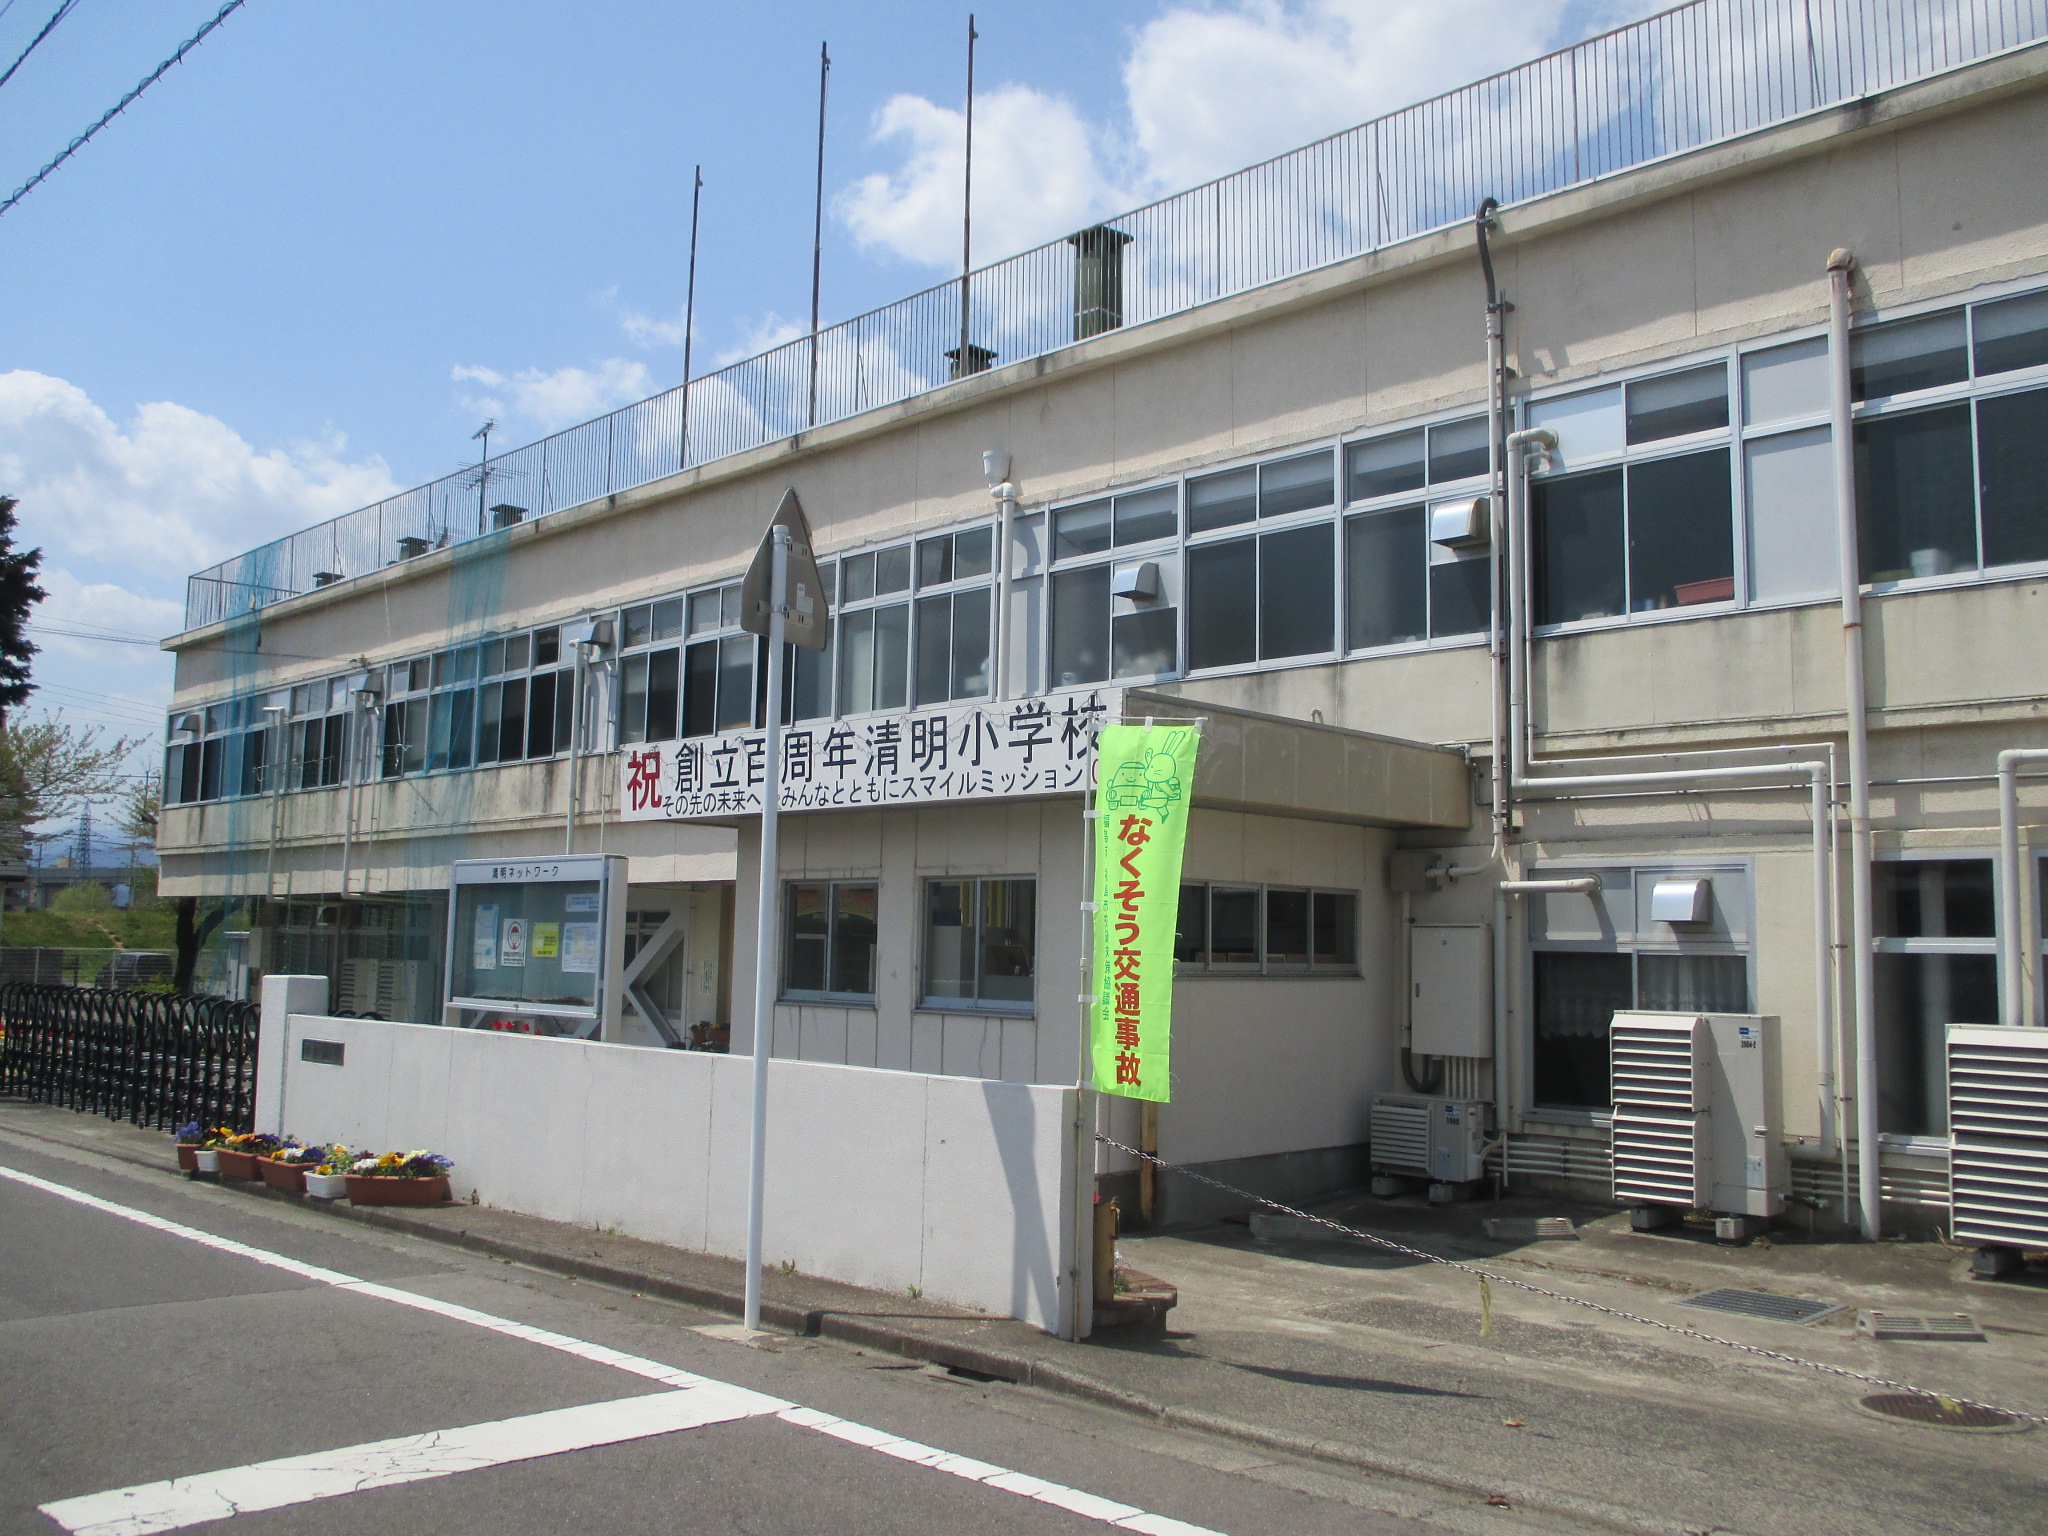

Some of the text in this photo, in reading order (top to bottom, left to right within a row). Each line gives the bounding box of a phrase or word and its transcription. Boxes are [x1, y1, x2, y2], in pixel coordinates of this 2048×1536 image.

[627, 694, 1107, 811] 祝 創立百周年清明小学校
[492, 866, 559, 879] 清明ネットワーク
[1113, 813, 1153, 1087] なくそう交通事故
